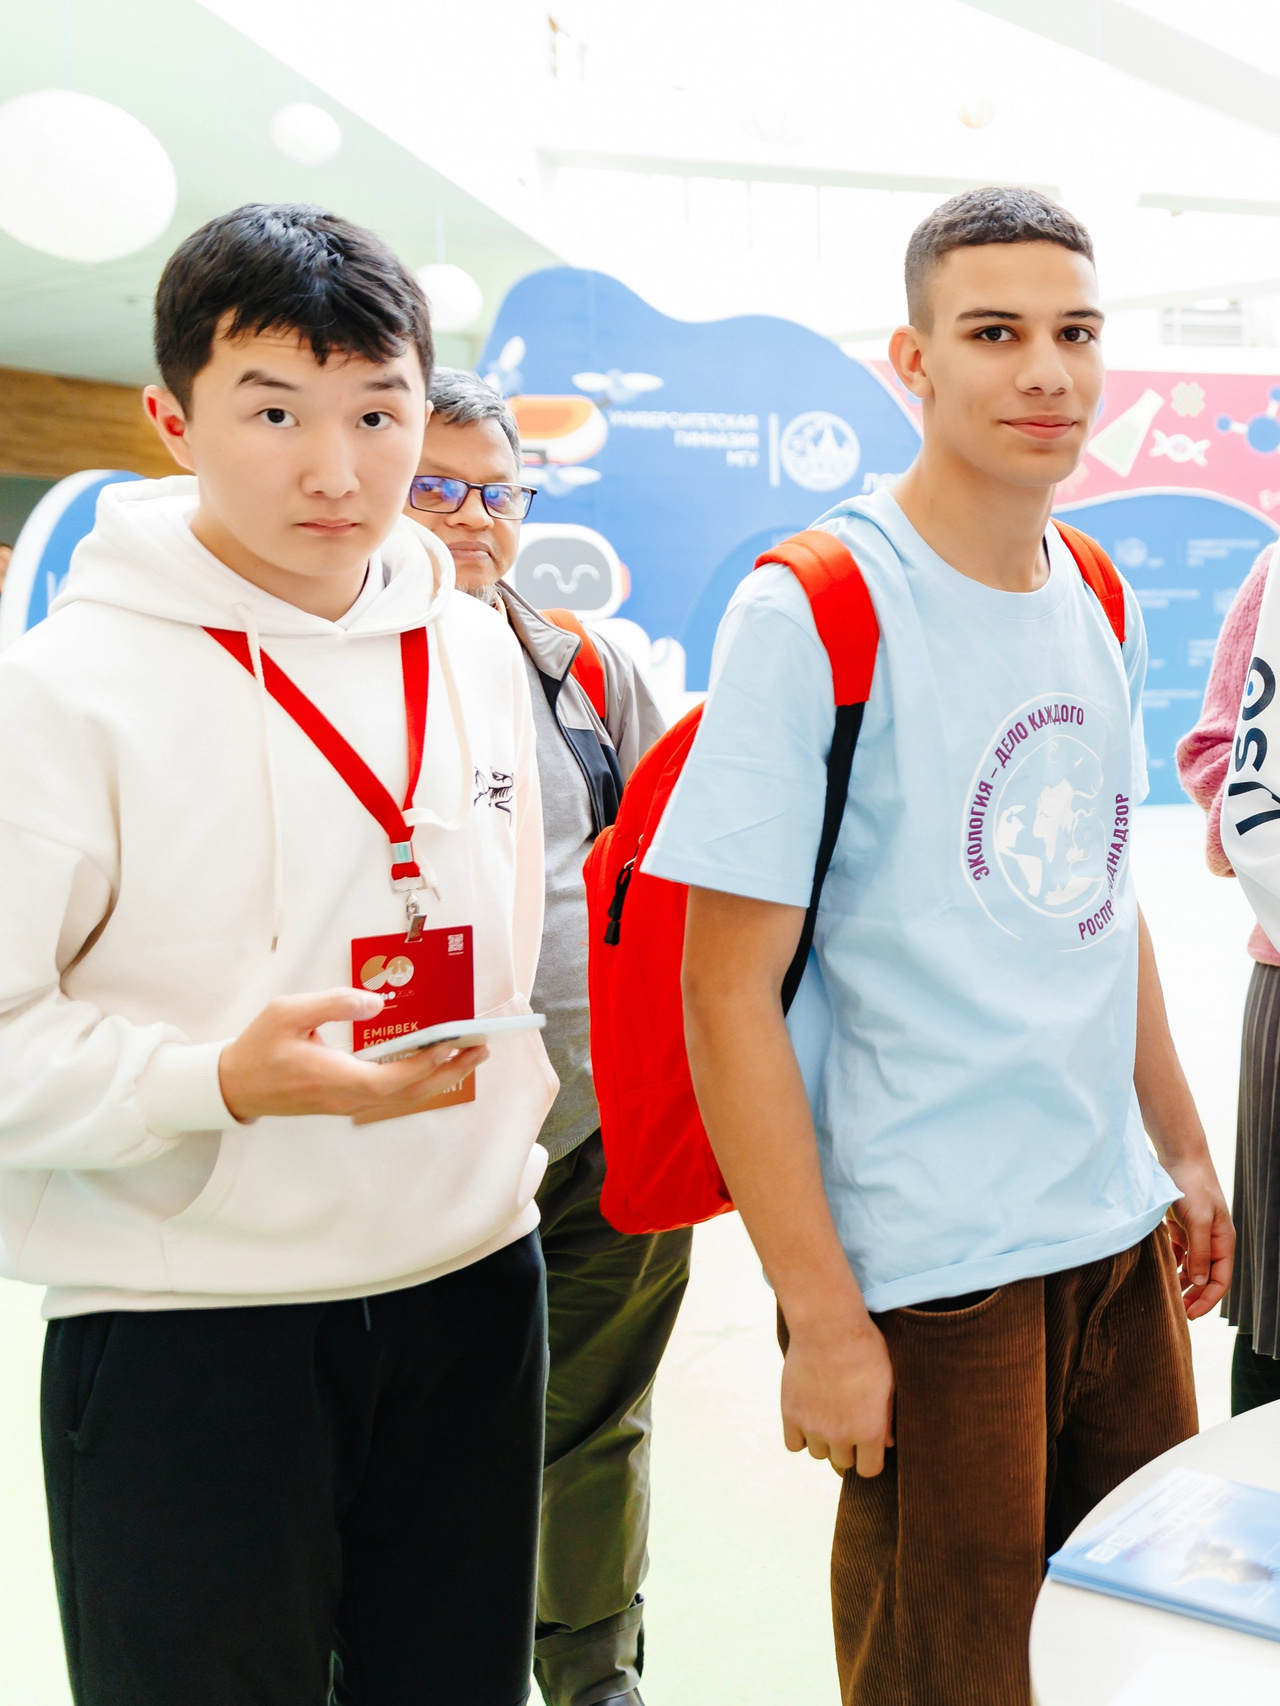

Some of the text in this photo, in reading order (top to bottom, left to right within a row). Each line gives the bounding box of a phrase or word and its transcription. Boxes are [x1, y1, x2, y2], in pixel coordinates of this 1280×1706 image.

[608, 410, 759, 430] УНИВЕРСИТЕТСКАЯ
[674, 430, 759, 449] ГИМНАЗИЯ
[726, 450, 759, 467] МГУ
[966, 780, 994, 881] ЭКОЛОГИЯ
[994, 721, 1029, 768] ДЕЛО
[1028, 704, 1085, 732] КАЖДОГО
[1078, 793, 1130, 940] РОСПРОДНАДЗОР
[363, 1021, 419, 1039] EMIRBEK
